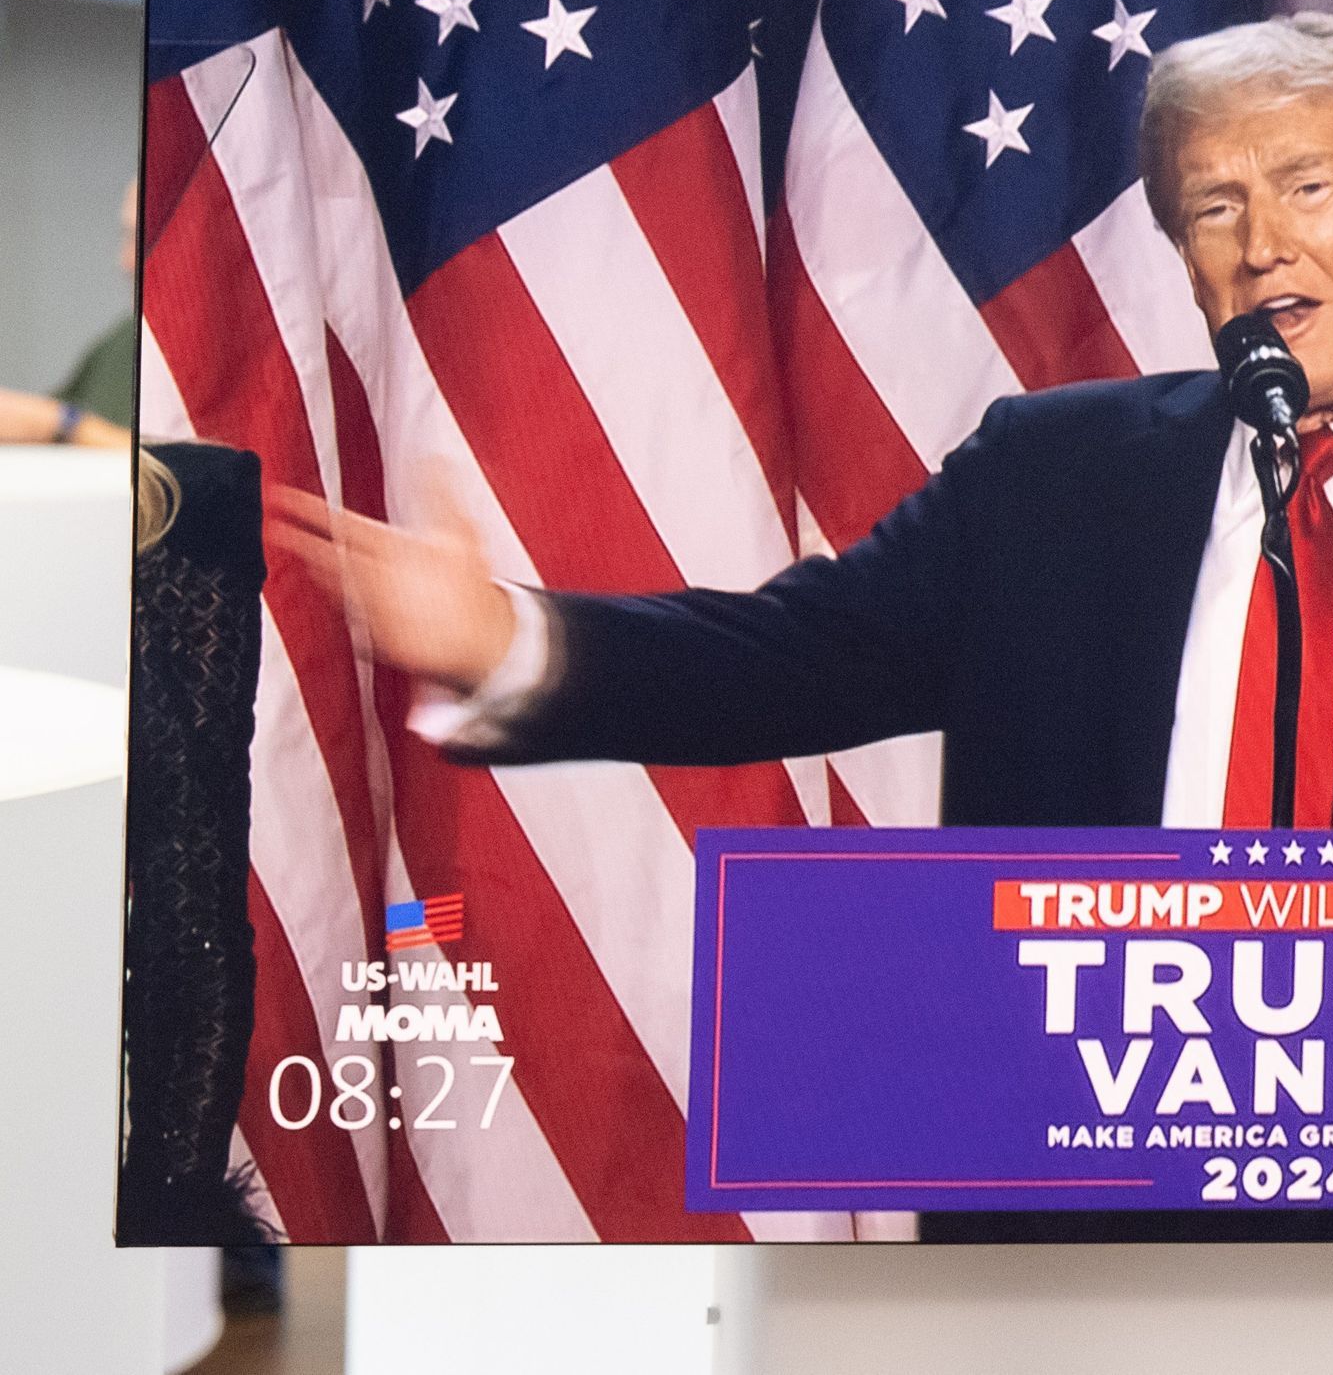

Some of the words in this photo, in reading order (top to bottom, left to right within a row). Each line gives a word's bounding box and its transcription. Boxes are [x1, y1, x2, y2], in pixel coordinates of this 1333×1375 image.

[1020, 883, 1223, 928] TRUMP
[340, 960, 499, 992] US-WAHL
[335, 1005, 504, 1042] MOMA
[269, 1055, 515, 1130] 08:27
[1047, 1125, 1133, 1148] MAKE
[1146, 1125, 1288, 1148] AMERICA
